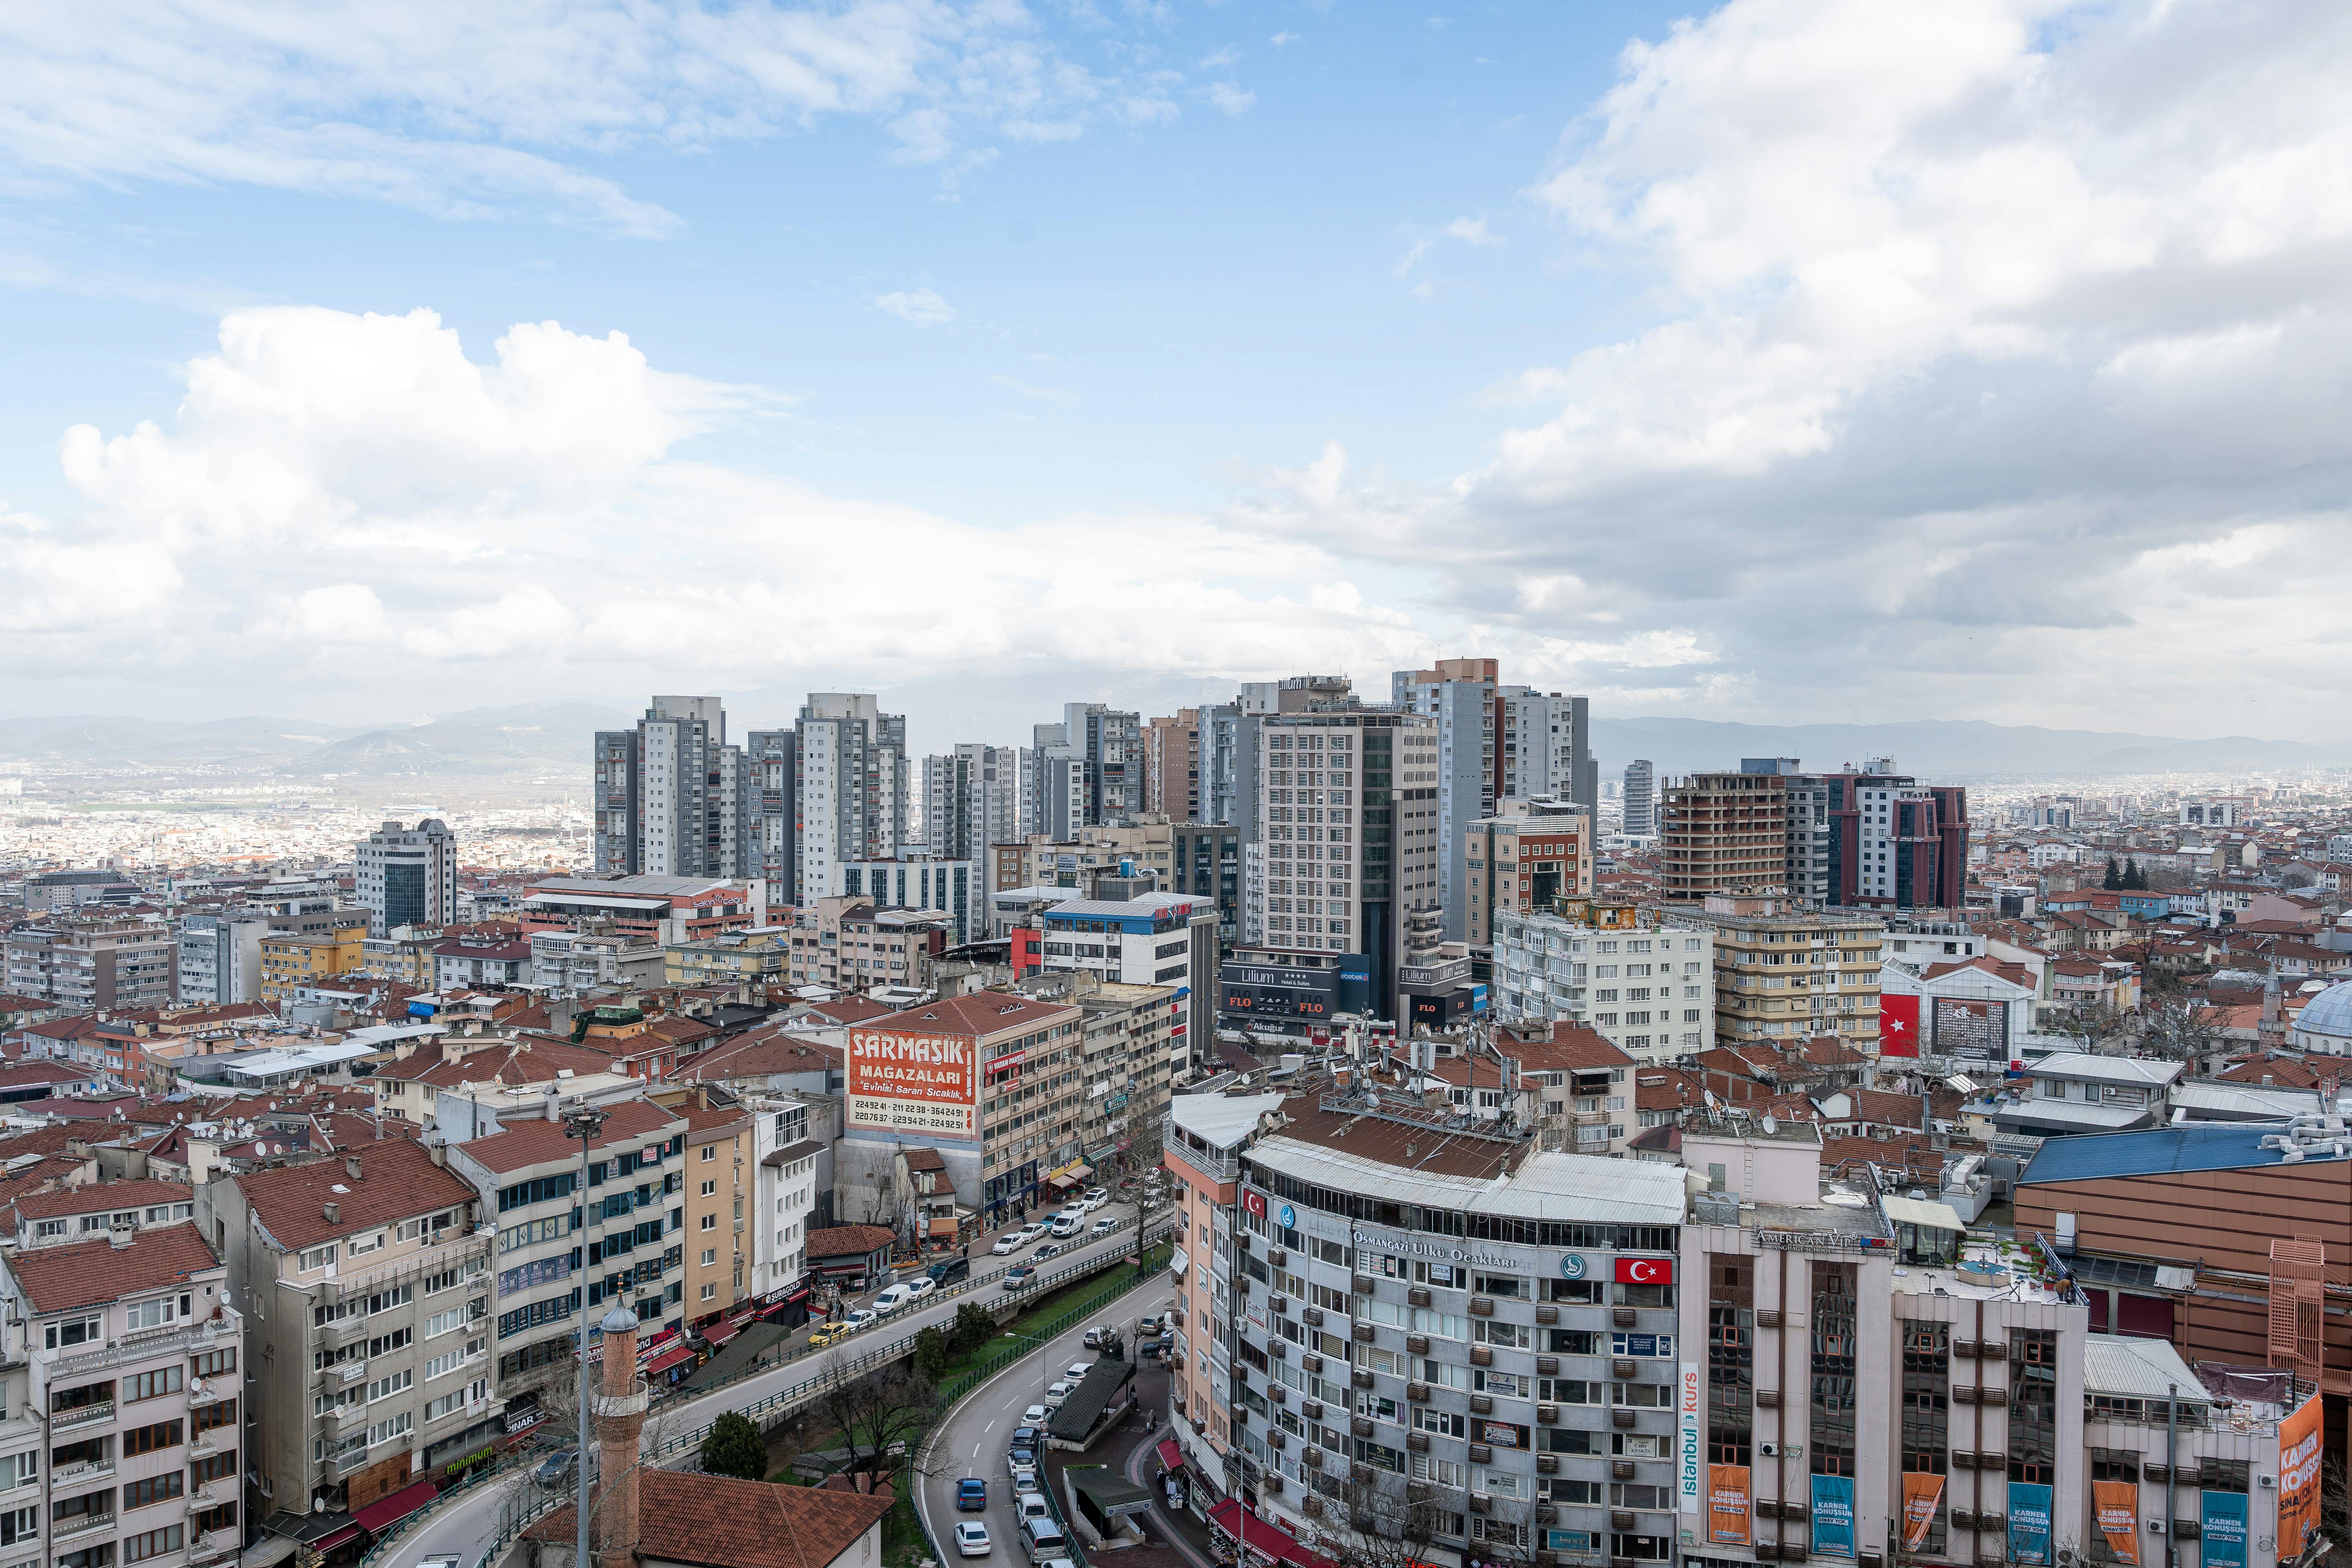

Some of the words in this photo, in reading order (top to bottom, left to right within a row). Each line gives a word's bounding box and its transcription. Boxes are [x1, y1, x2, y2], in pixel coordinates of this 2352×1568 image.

[693, 899, 715, 908] salon
[1177, 903, 1192, 916] KURS
[1242, 970, 1274, 984] Lilium
[1406, 970, 1431, 980] Lilium
[1439, 967, 1453, 980] Lilium
[1229, 997, 1251, 1007] FLO
[1299, 1002, 1323, 1013] FLO
[1253, 1023, 1285, 1033] Akuğur
[853, 1034, 964, 1065] SARMAŞIK
[993, 1059, 1008, 1070] VATAN
[1008, 1053, 1025, 1065] PARTİSİ
[860, 1065, 960, 1084] MAĞAZALARI
[896, 1085, 923, 1095] Saran
[931, 1107, 945, 1115] 364
[931, 1119, 945, 1127] 224
[1006, 1192, 1022, 1205] Venesa
[1860, 1238, 1894, 1247] MOON
[771, 1281, 800, 1302] ŞURAGOLD
[654, 1327, 674, 1344] Depo
[1682, 1373, 1697, 1412] kurs
[2281, 1430, 2317, 1471] KARNEN
[447, 1446, 492, 1474] minimum
[1682, 1428, 1697, 1496] istanbul
[2015, 1509, 2046, 1518] KARNEN
[2209, 1518, 2241, 1526] KARNEN
[1251, 1546, 1274, 1564] AYAKKABI
